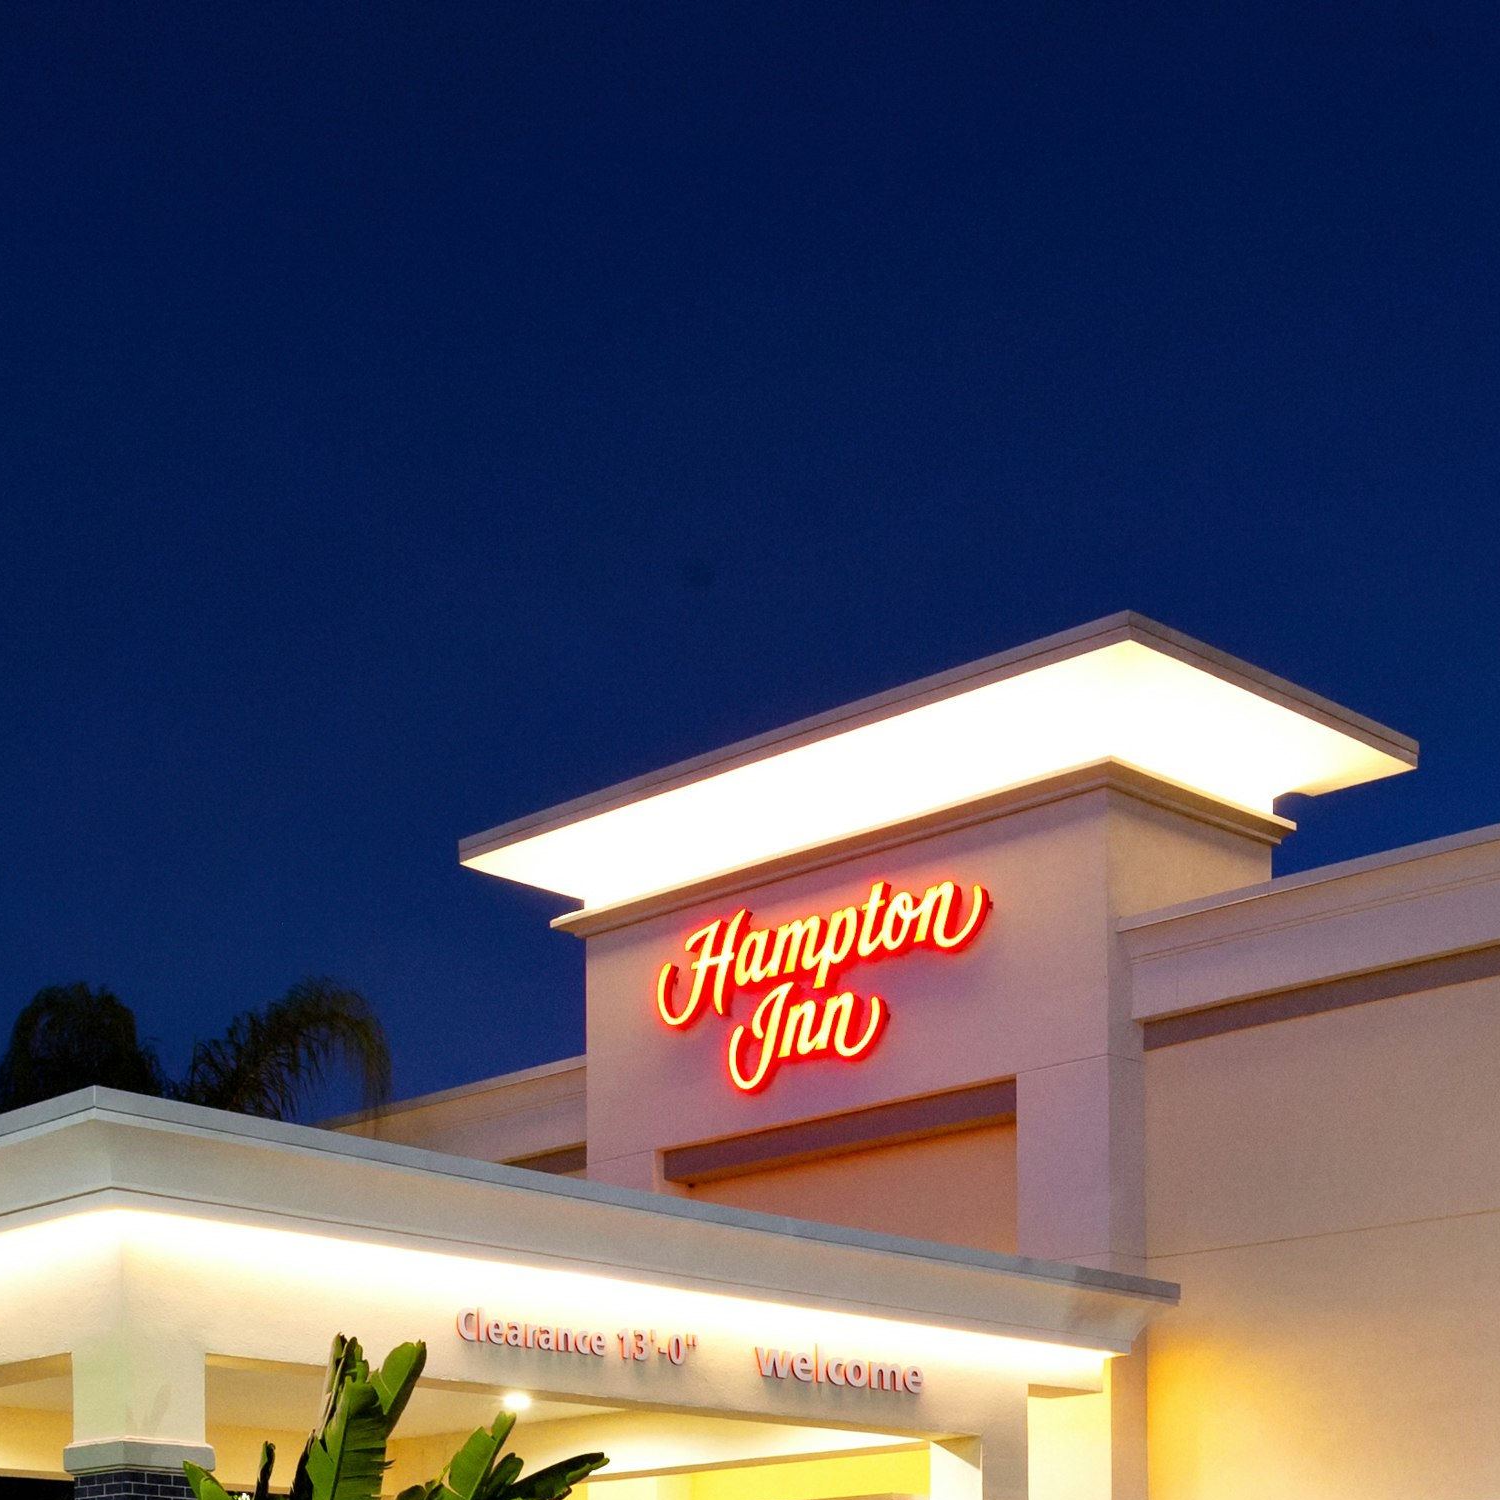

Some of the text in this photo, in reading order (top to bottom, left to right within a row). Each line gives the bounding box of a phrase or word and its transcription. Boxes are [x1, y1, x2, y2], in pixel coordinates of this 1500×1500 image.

[657, 881, 991, 1026] Hampton
[728, 981, 889, 1091] Inn
[456, 1306, 606, 1357] Clearance
[755, 1343, 924, 1394] welcome
